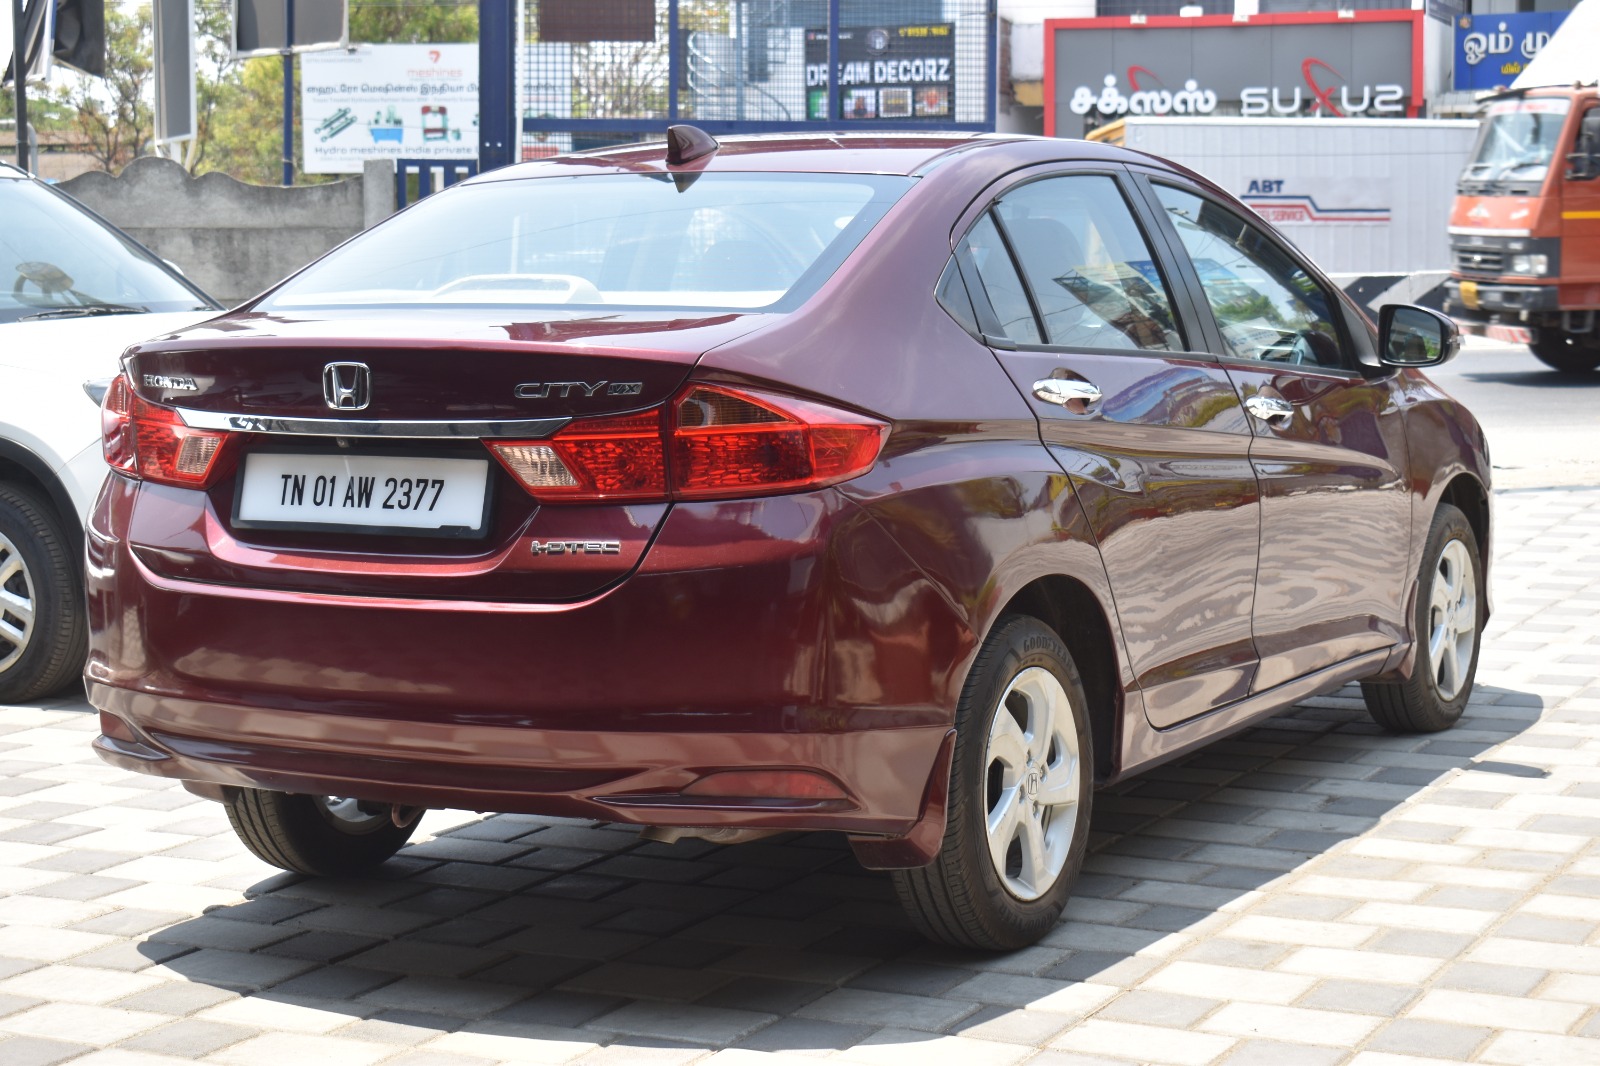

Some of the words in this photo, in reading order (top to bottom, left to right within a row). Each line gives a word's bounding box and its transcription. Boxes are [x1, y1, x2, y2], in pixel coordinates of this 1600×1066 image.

[1463, 22, 1513, 65] ஓம்
[407, 68, 463, 77] meshines
[874, 58, 950, 83] DECORZ
[1070, 70, 1217, 115] சக்ஸஸ்
[315, 146, 347, 155] Hydro
[350, 146, 402, 154] meshines
[405, 146, 432, 154] india
[434, 146, 472, 155] private
[1248, 180, 1284, 193] ABT
[143, 374, 199, 391] HONDA
[514, 380, 608, 398] CITY
[607, 382, 643, 395] VX
[281, 474, 306, 506] TN
[313, 475, 336, 507] 01
[343, 476, 375, 508] AW
[382, 477, 445, 511] 2377
